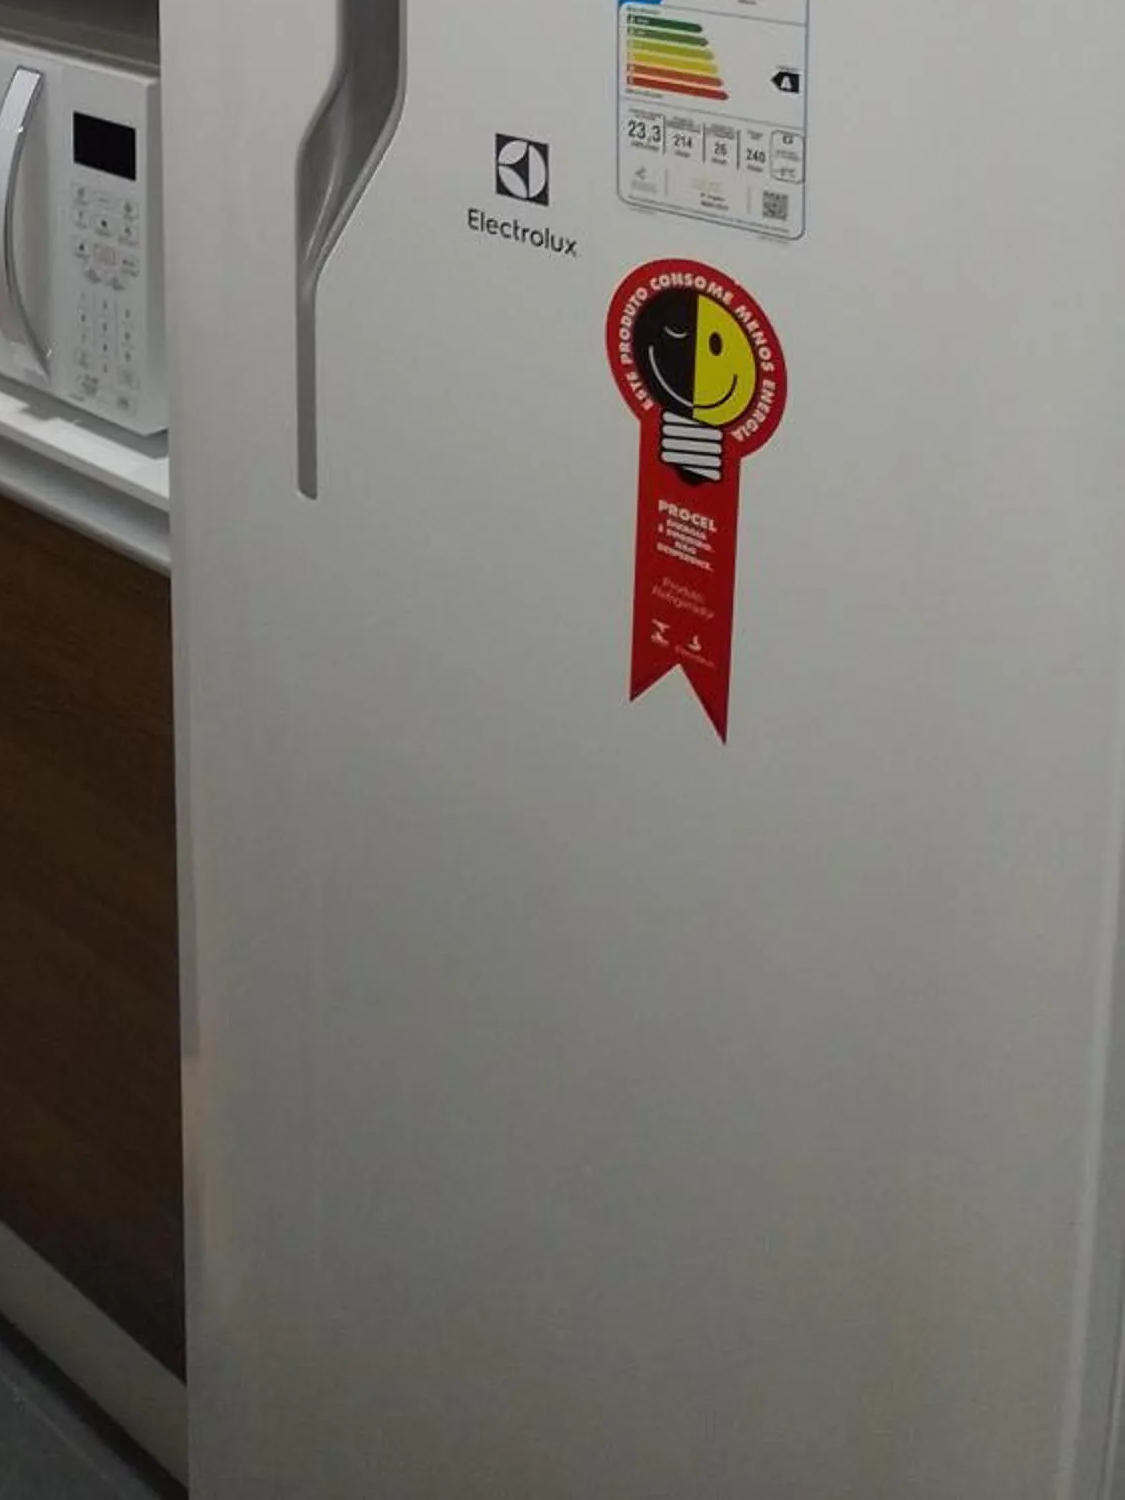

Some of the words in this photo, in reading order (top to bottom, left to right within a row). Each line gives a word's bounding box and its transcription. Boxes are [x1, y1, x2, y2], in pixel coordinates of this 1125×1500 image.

[467, 207, 578, 257] Electrolux
[649, 272, 735, 305] CONSOME
[619, 287, 648, 365] PRODUTO
[734, 305, 774, 373] MENOS
[626, 371, 654, 411] ESTE
[730, 379, 776, 442] ENERGIA
[658, 499, 718, 533] PROCEL
